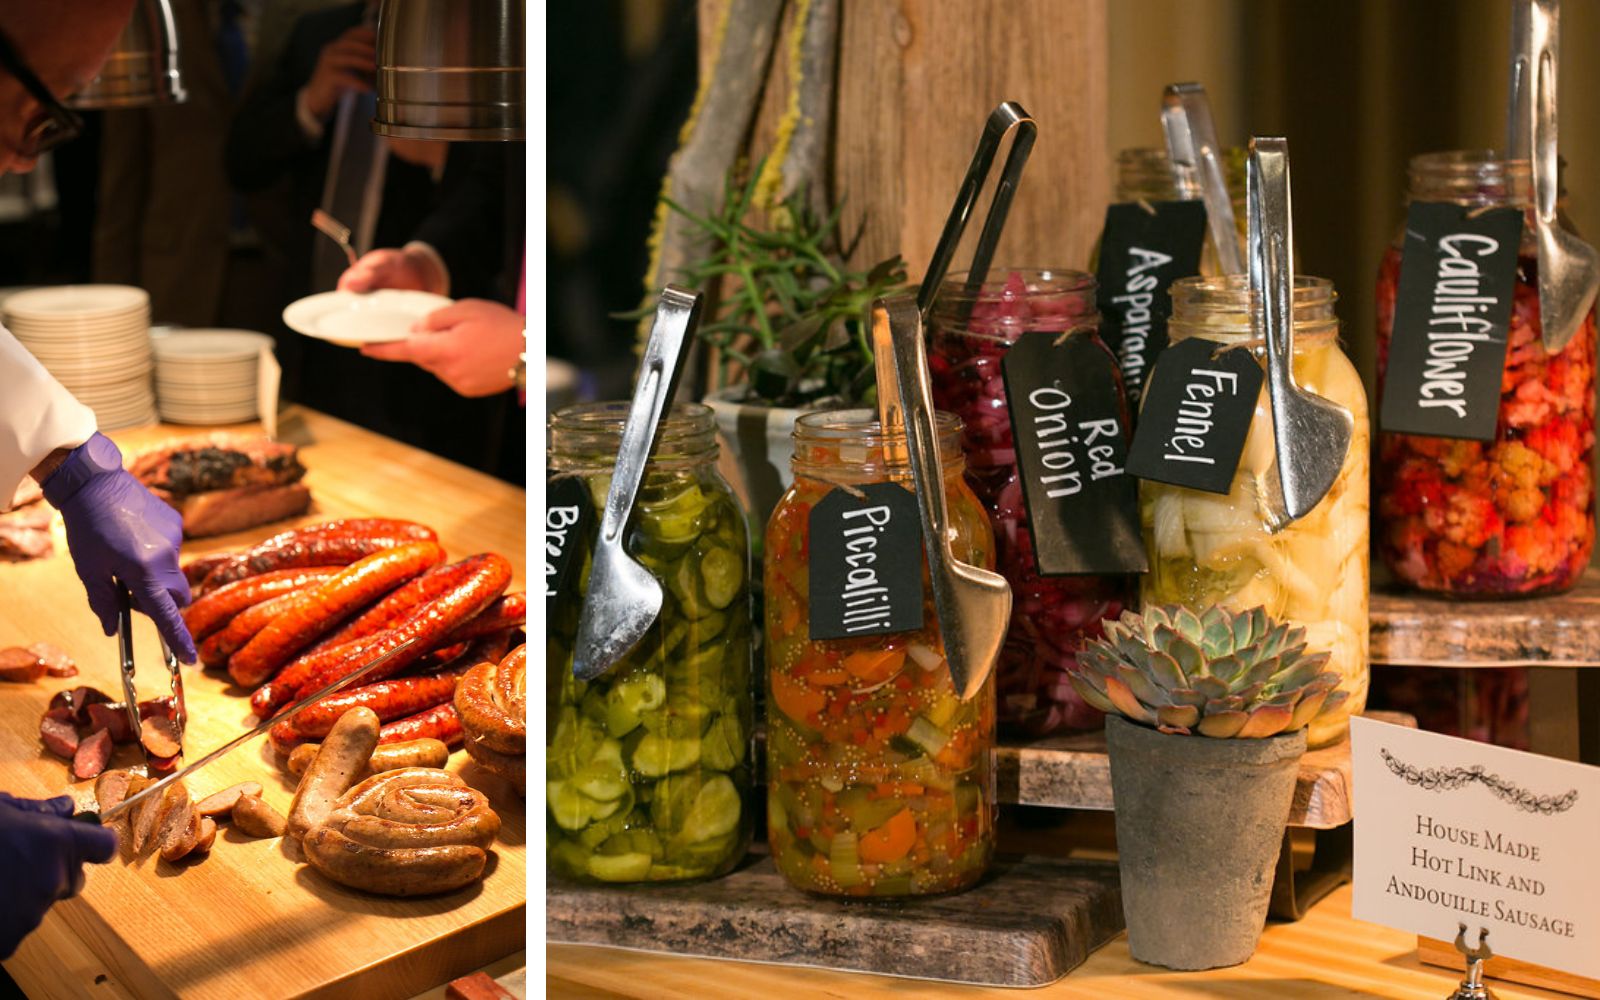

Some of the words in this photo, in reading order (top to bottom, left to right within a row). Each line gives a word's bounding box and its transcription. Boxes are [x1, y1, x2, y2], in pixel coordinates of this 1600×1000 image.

[1418, 233, 1499, 418] Cauliflower
[1028, 386, 1083, 500] Onion
[1078, 417, 1125, 481] Red
[1163, 368, 1238, 465] Fennel
[841, 505, 891, 632] Piccalilli
[1411, 847, 1454, 874] HOT
[1457, 857, 1501, 887] LINK
[1506, 877, 1546, 897] AND
[1416, 814, 1479, 849] HOUSE
[1483, 830, 1541, 863] MADE
[1386, 875, 1490, 918] ANDOUILLE
[1494, 900, 1575, 938] SAUSAGE
